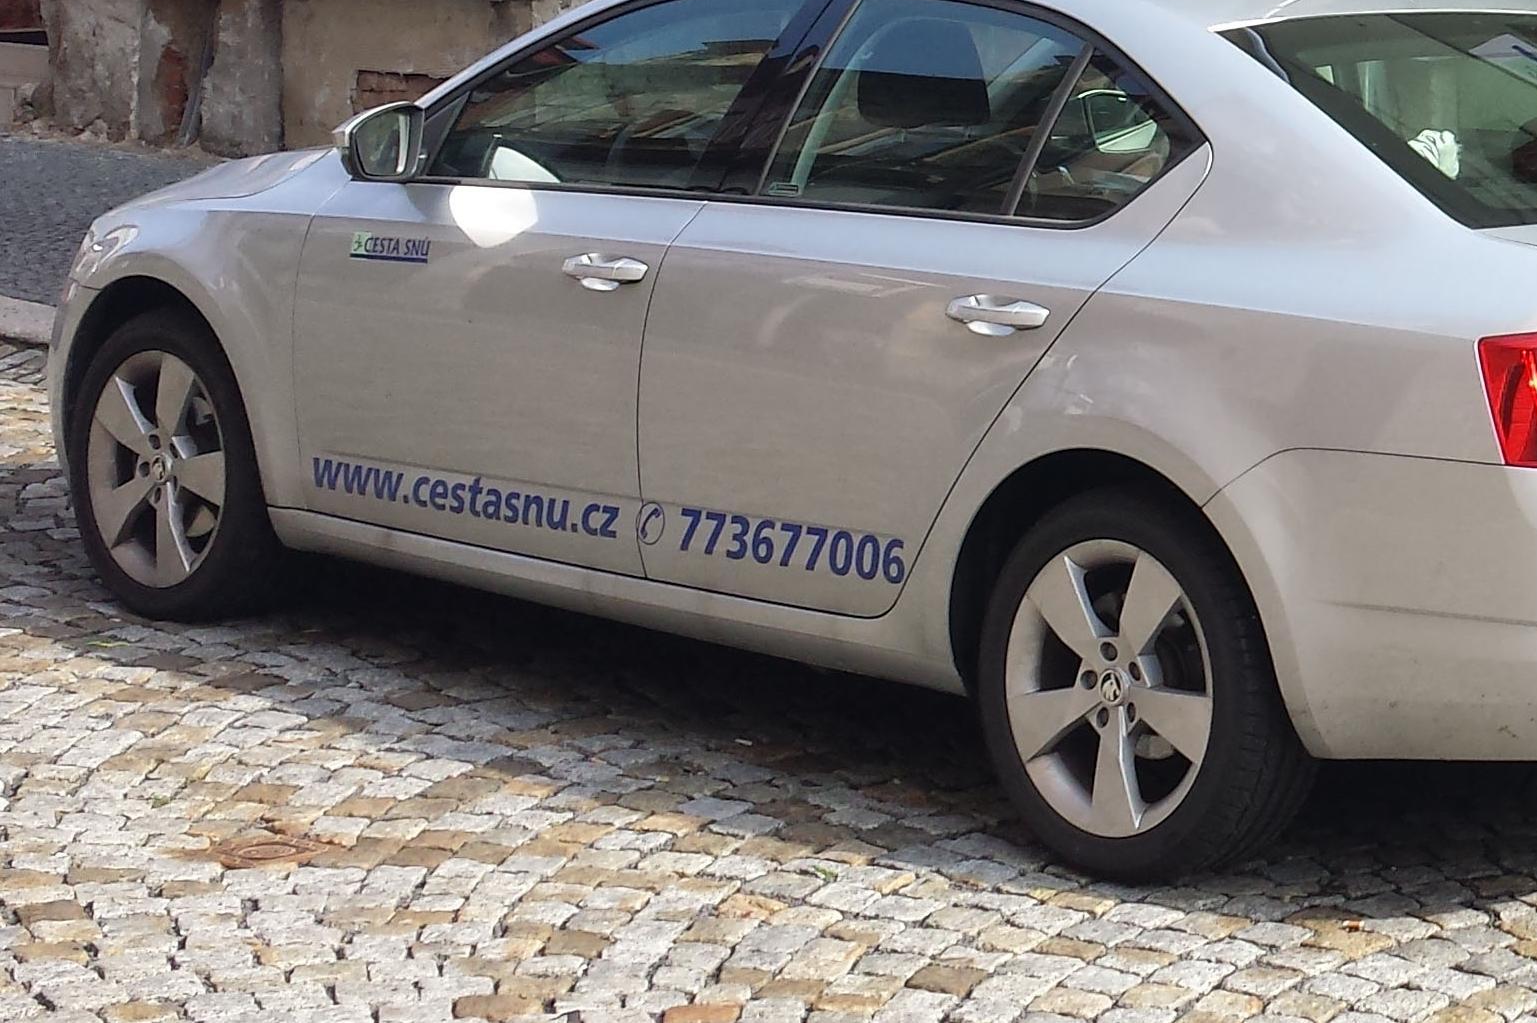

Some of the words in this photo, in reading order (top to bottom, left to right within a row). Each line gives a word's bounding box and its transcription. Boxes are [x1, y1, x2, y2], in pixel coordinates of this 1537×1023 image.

[364, 237, 400, 255] CESTA
[312, 456, 619, 540] www.cestasnu.cz
[680, 507, 907, 585] 773677006
